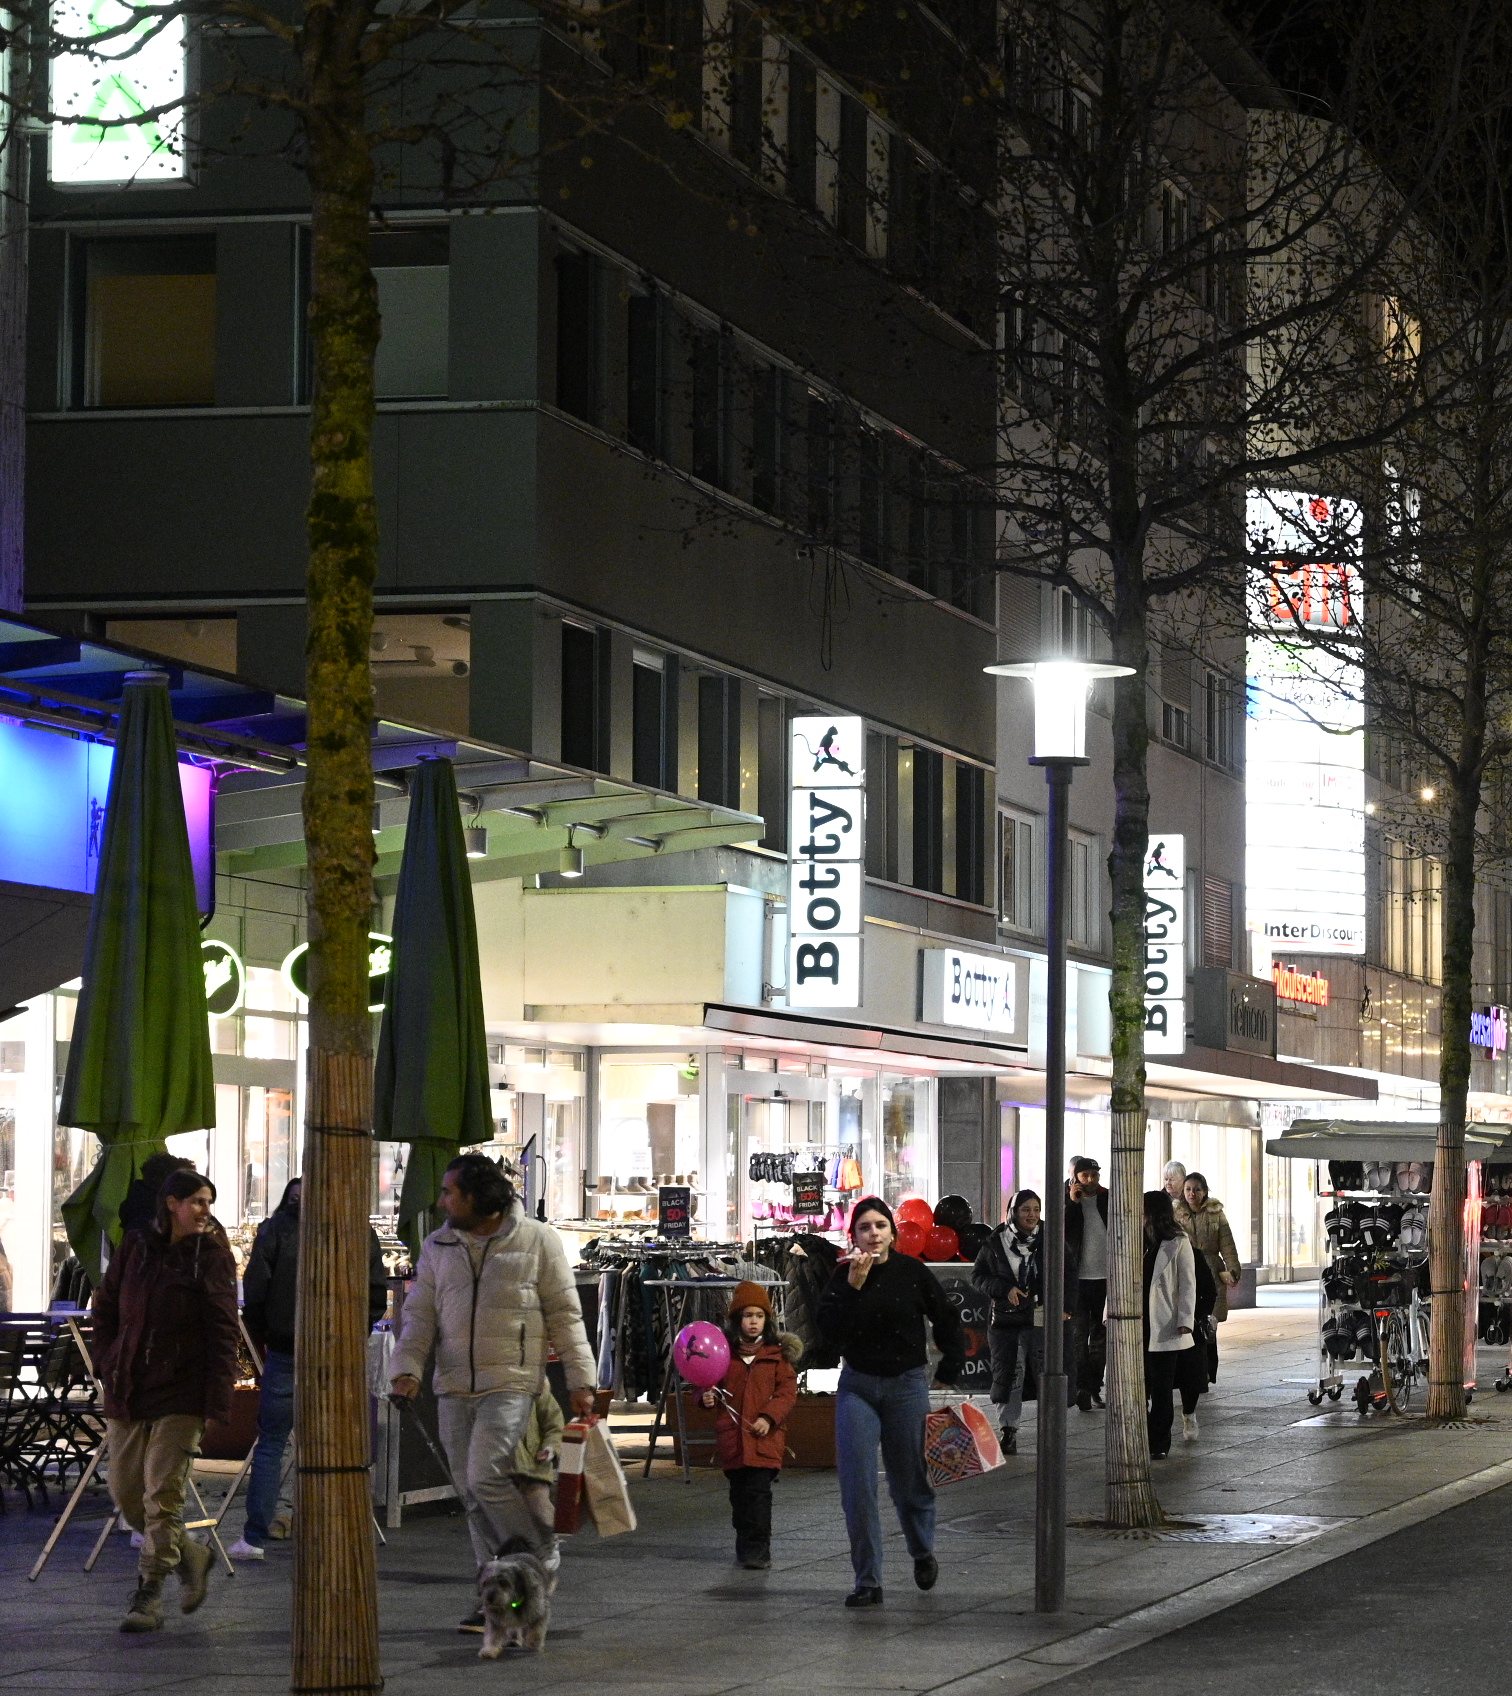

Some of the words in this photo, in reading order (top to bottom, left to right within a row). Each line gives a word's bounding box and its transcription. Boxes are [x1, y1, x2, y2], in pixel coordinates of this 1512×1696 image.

[796, 791, 853, 986] Botty
[1264, 922, 1363, 941] InterDiscoun
[951, 957, 1000, 1021] Botty
[1271, 959, 1329, 1007] inkaufscenter
[662, 1199, 685, 1207] BLACK
[798, 1201, 820, 1209] FRIDAY
[663, 1222, 687, 1230] FRIDAY
